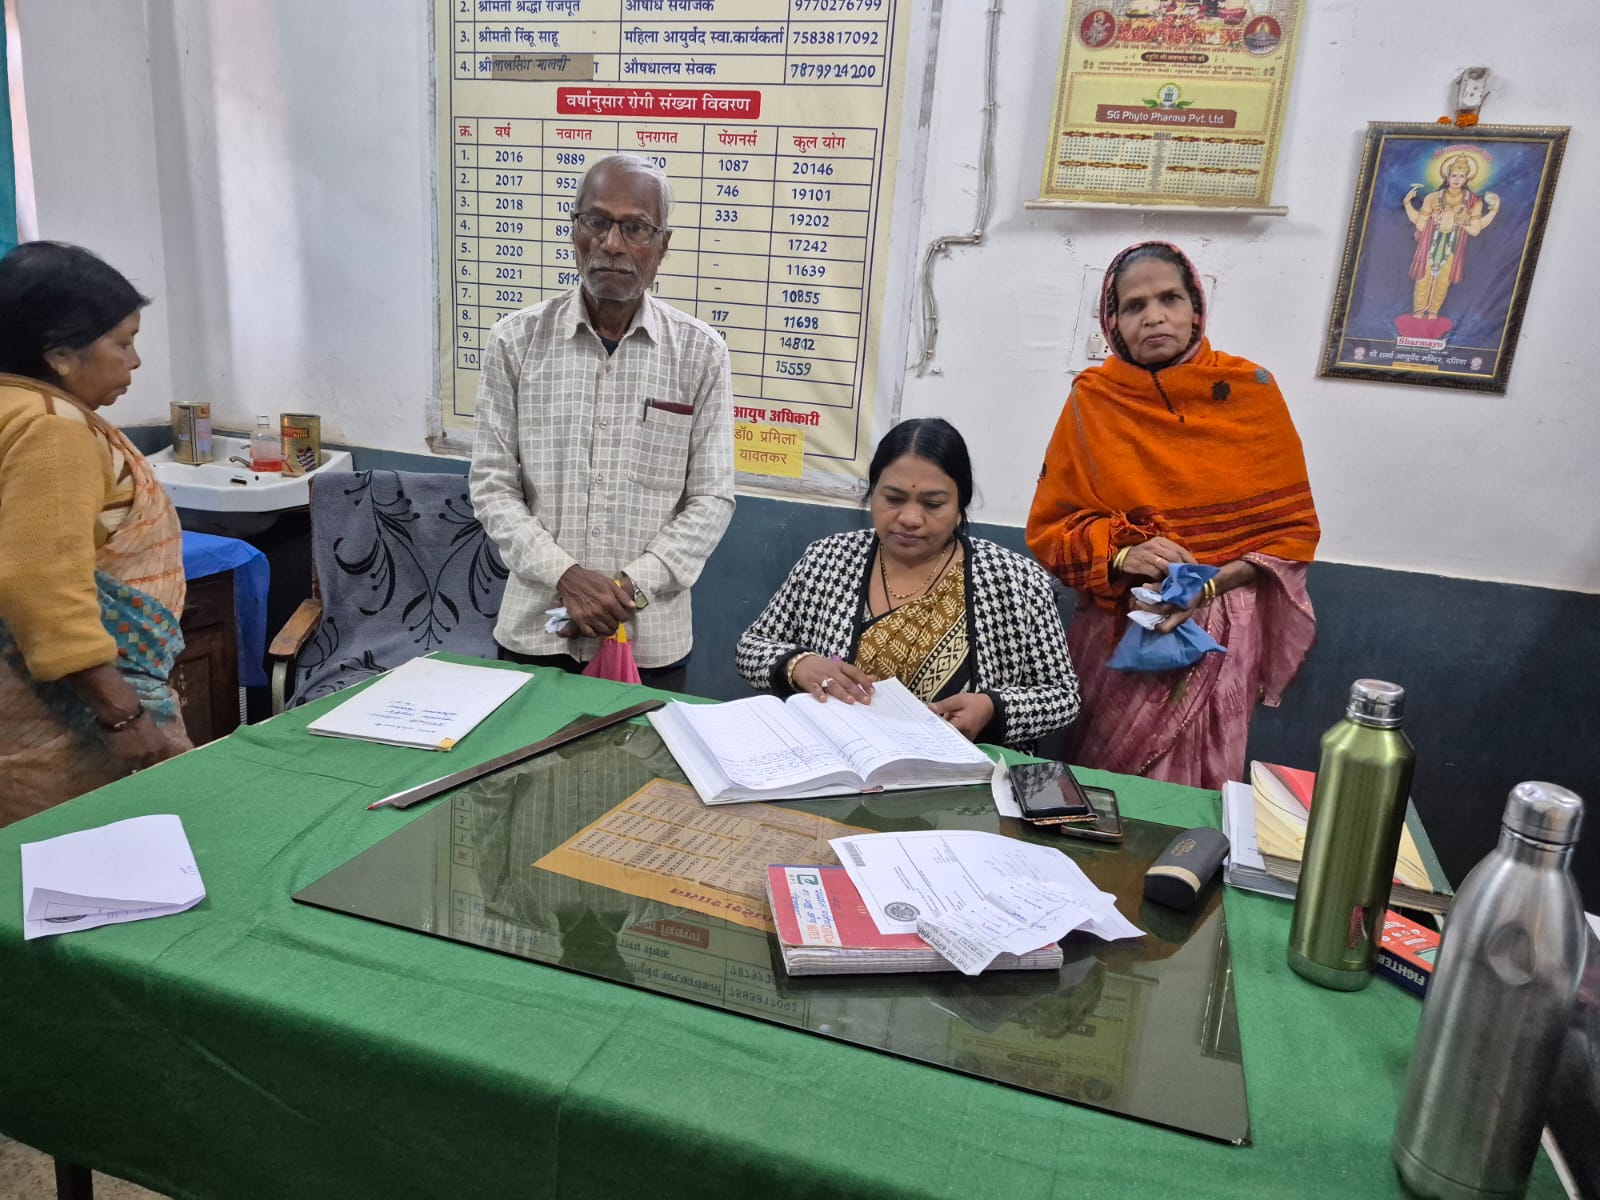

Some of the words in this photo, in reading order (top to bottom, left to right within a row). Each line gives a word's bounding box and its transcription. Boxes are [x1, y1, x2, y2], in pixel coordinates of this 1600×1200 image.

[460, 31, 470, 42] 3.
[478, 27, 511, 42] श्रीमती
[515, 26, 536, 47] रिंकू
[538, 31, 560, 47] साहू
[624, 27, 659, 44] महिला
[663, 26, 706, 48] आयुर्वेद
[793, 31, 878, 45] 7583817092
[460, 62, 470, 72] 4.
[479, 57, 492, 72] श्री
[624, 58, 681, 75] औषधालय
[685, 58, 717, 75] सेवक
[566, 91, 625, 112] वर्षानुसार
[627, 90, 654, 110] रोगी
[660, 92, 697, 111] संख्या
[702, 93, 751, 112] विवरण
[1107, 110, 1120, 120] SG
[1122, 111, 1149, 122] Phyto
[1150, 112, 1187, 123] Pharma
[459, 125, 472, 137] क्र.
[494, 122, 511, 138] वर्ष
[556, 128, 592, 141] नवागत
[636, 130, 679, 147] पुनरागत
[718, 128, 758, 146] पेंशनर्स
[793, 136, 818, 153] कुल
[821, 132, 846, 149] योग
[461, 150, 470, 161] 1.
[495, 151, 523, 162] 2016
[556, 153, 585, 165] 9889
[719, 159, 749, 172] 1087
[792, 162, 834, 176] 20146
[461, 173, 470, 184] 2.
[495, 174, 523, 186] 2017
[556, 177, 577, 189] 952
[716, 185, 740, 197] 746
[792, 188, 831, 202] 19101
[461, 197, 470, 208] 3.
[495, 198, 523, 210] 2018
[714, 210, 739, 222] 333
[789, 213, 830, 228] 19202
[460, 220, 471, 230] 4.
[495, 222, 523, 234] 2019
[788, 239, 828, 253] 17242
[461, 243, 471, 253] 5.
[495, 244, 523, 257] 2020
[787, 264, 826, 278] 11639
[461, 265, 471, 276] 6.
[495, 268, 523, 280] 2021
[782, 289, 821, 305] 10855
[462, 287, 472, 299] 7.
[495, 290, 523, 303] 2022
[783, 316, 819, 330] 11698
[462, 310, 472, 321] 8.
[462, 331, 472, 342] 9.
[775, 360, 812, 376] 15559
[464, 354, 479, 364] 10.
[733, 406, 766, 424] आयुष
[769, 407, 821, 426] अधिकारी
[760, 427, 797, 446] प्रमिला
